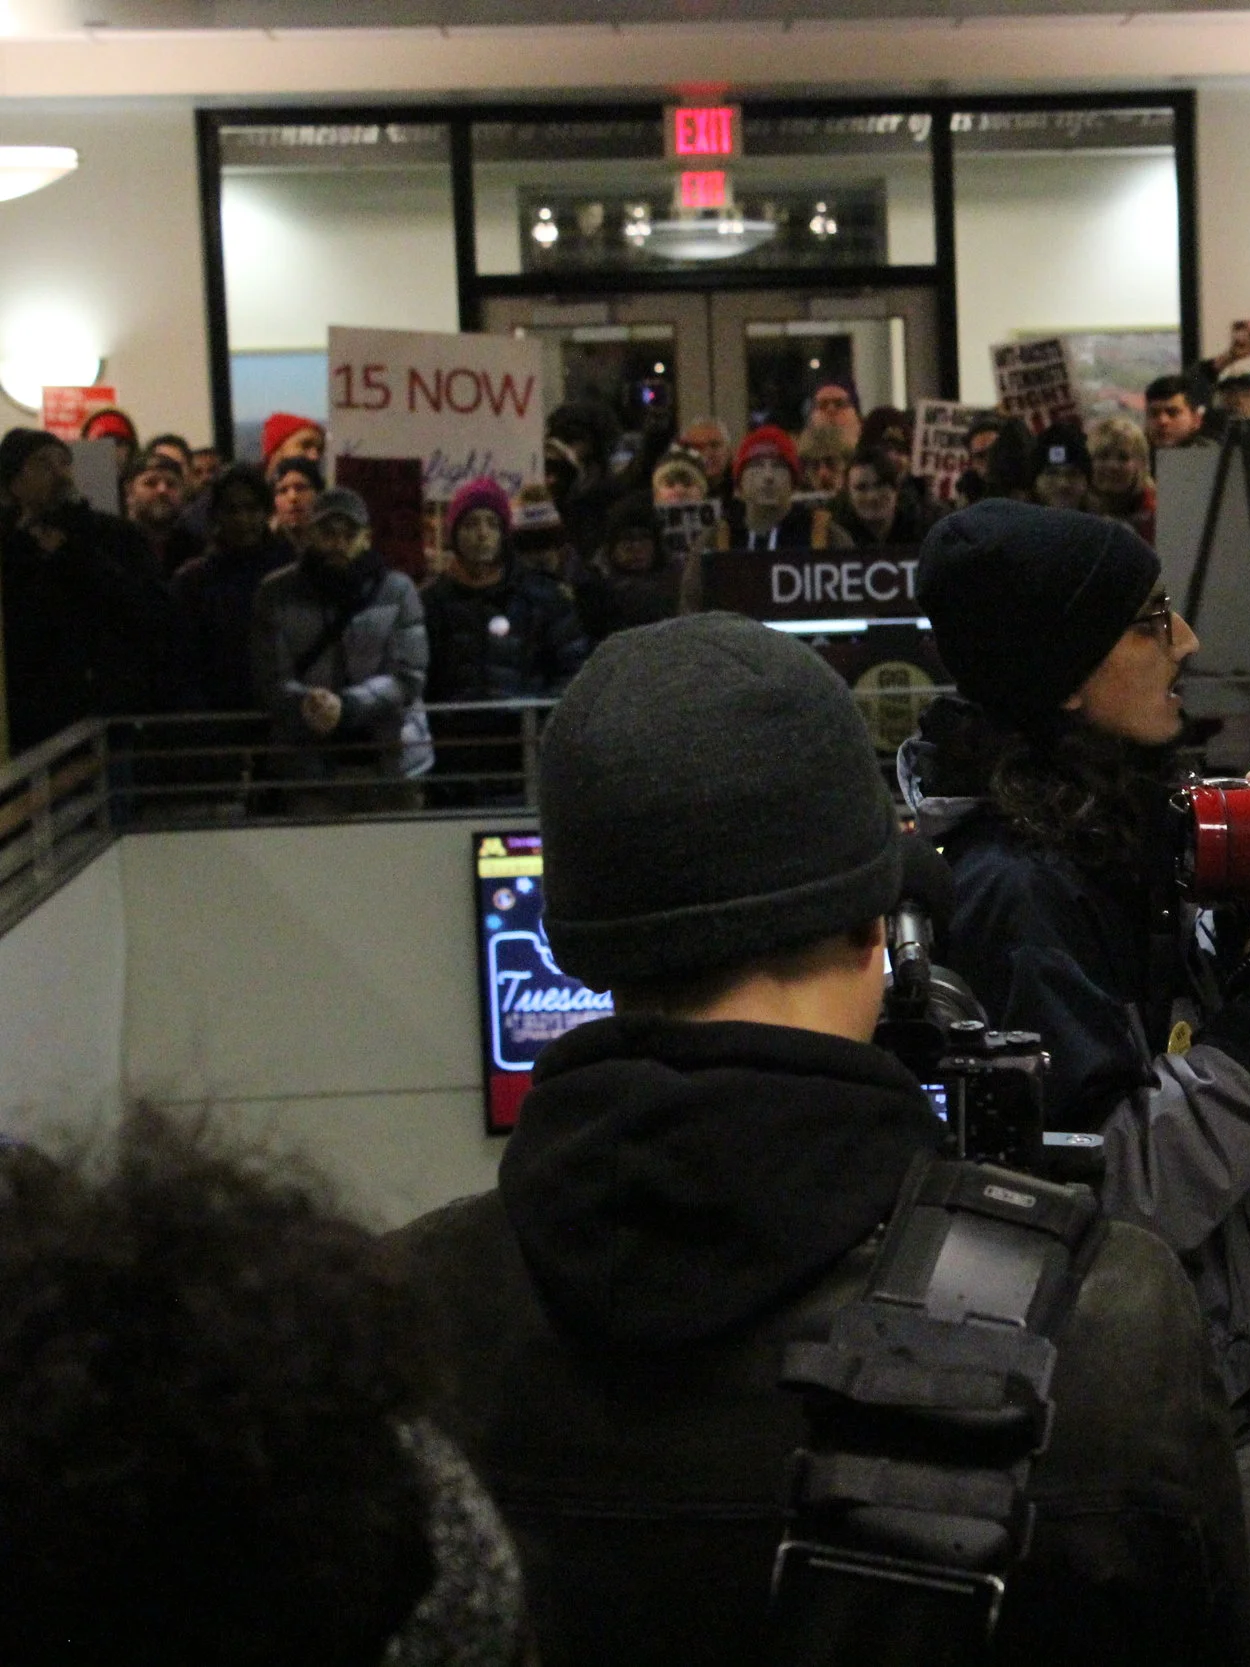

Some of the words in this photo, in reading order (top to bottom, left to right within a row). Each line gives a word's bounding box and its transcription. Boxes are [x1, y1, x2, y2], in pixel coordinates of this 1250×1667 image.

[675, 108, 733, 154] EXIT
[333, 364, 392, 411] 15
[407, 367, 536, 418] NOW
